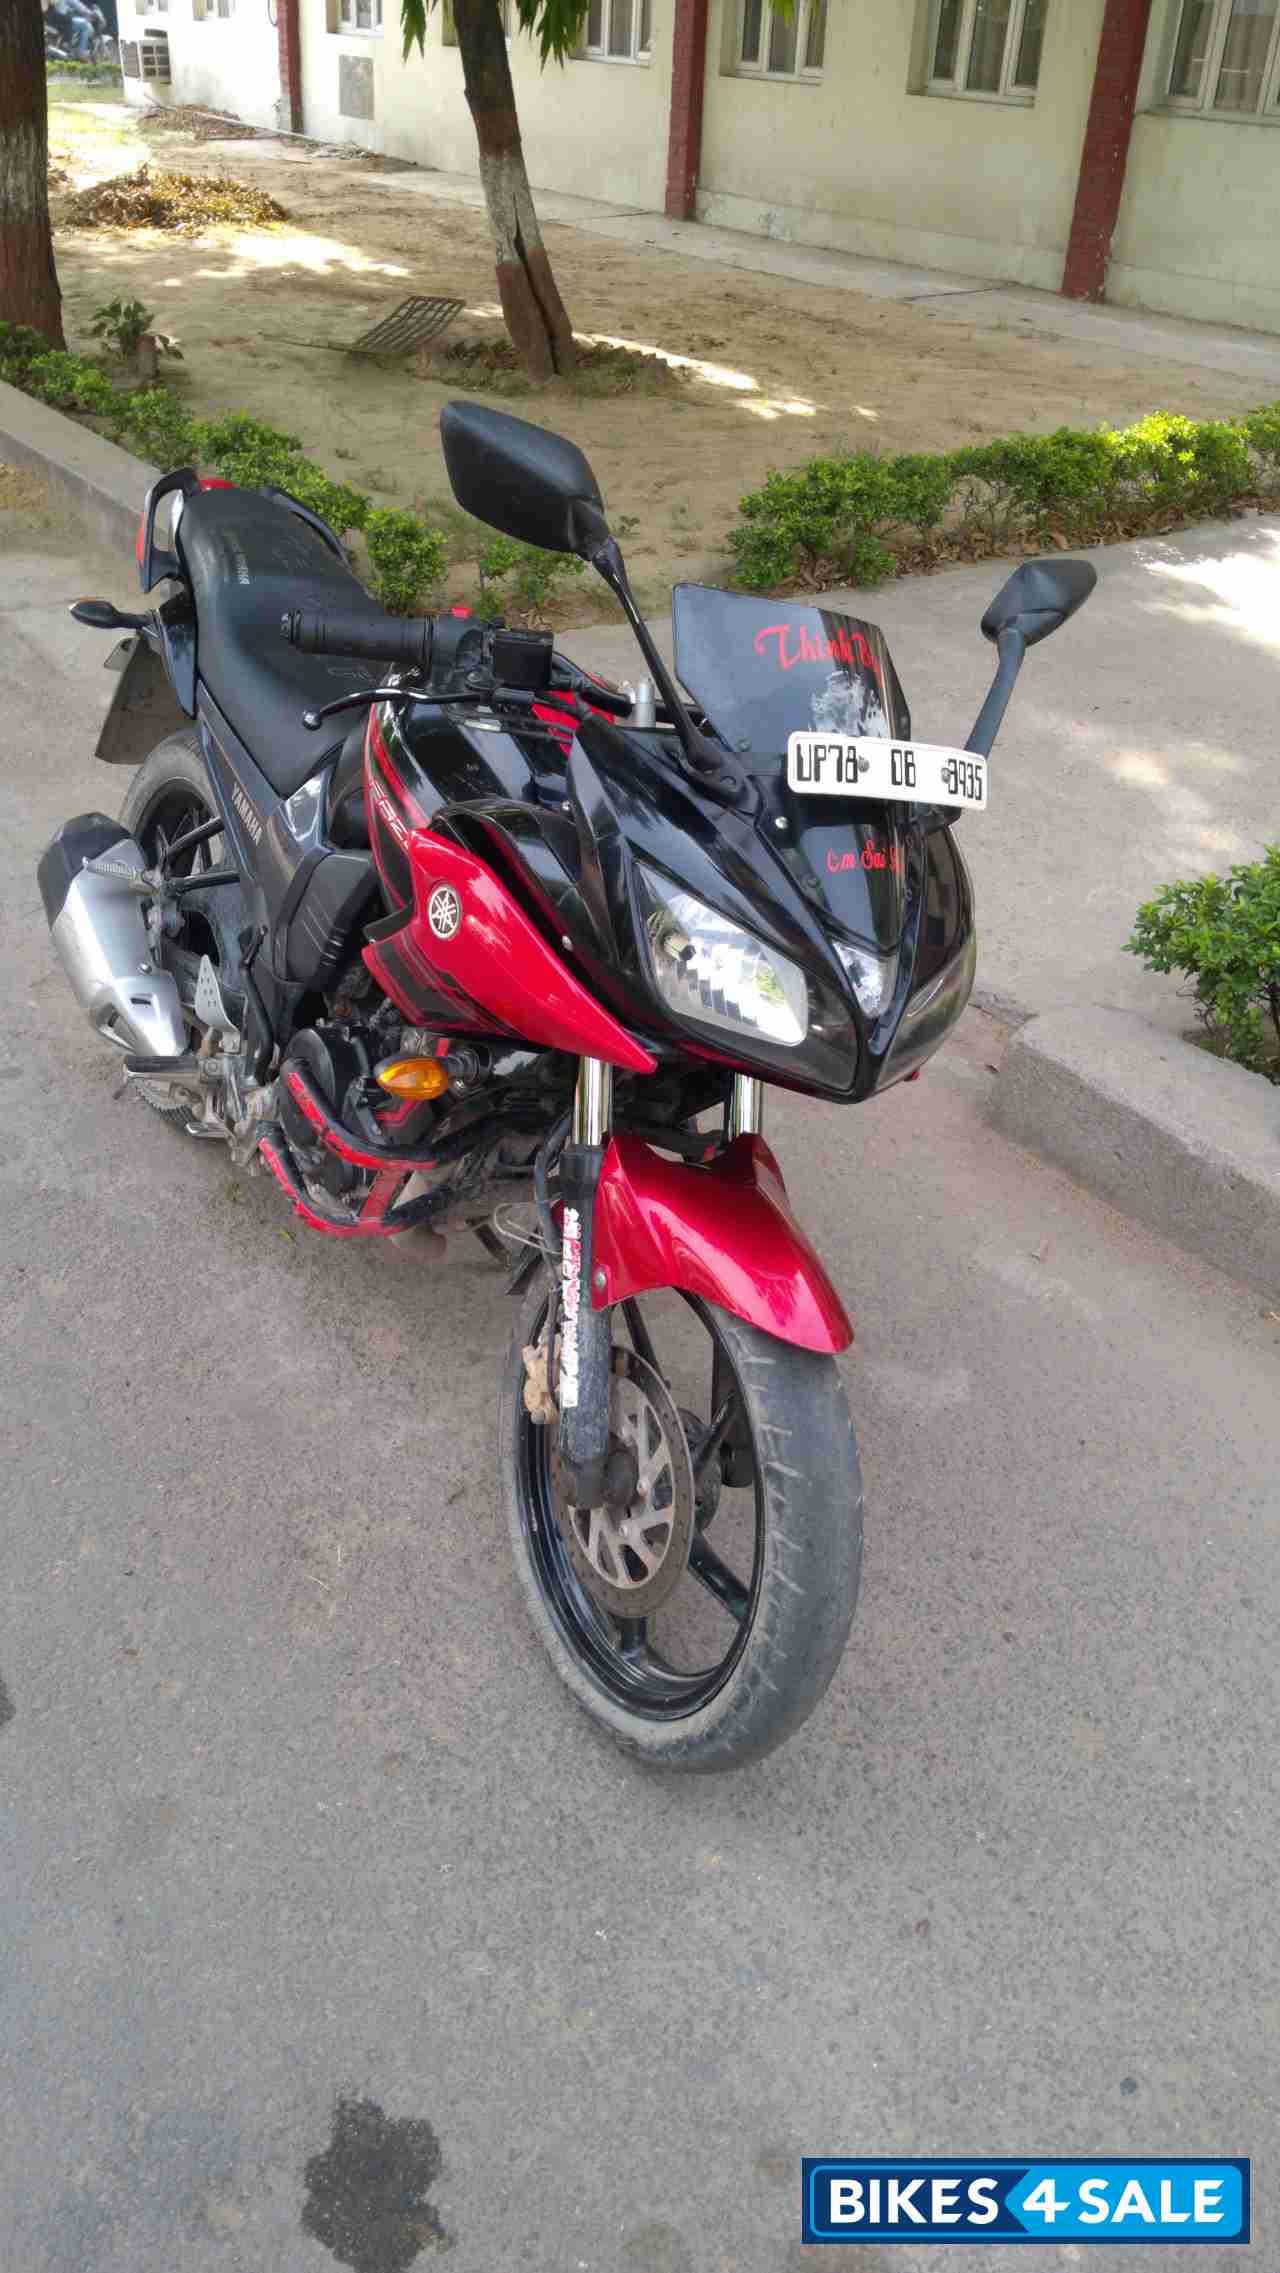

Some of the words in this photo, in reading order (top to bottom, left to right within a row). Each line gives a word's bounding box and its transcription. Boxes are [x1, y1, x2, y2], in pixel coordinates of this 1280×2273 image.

[797, 744, 858, 783] UP78
[948, 758, 982, 801] 3935
[231, 781, 262, 847] YAMAHA
